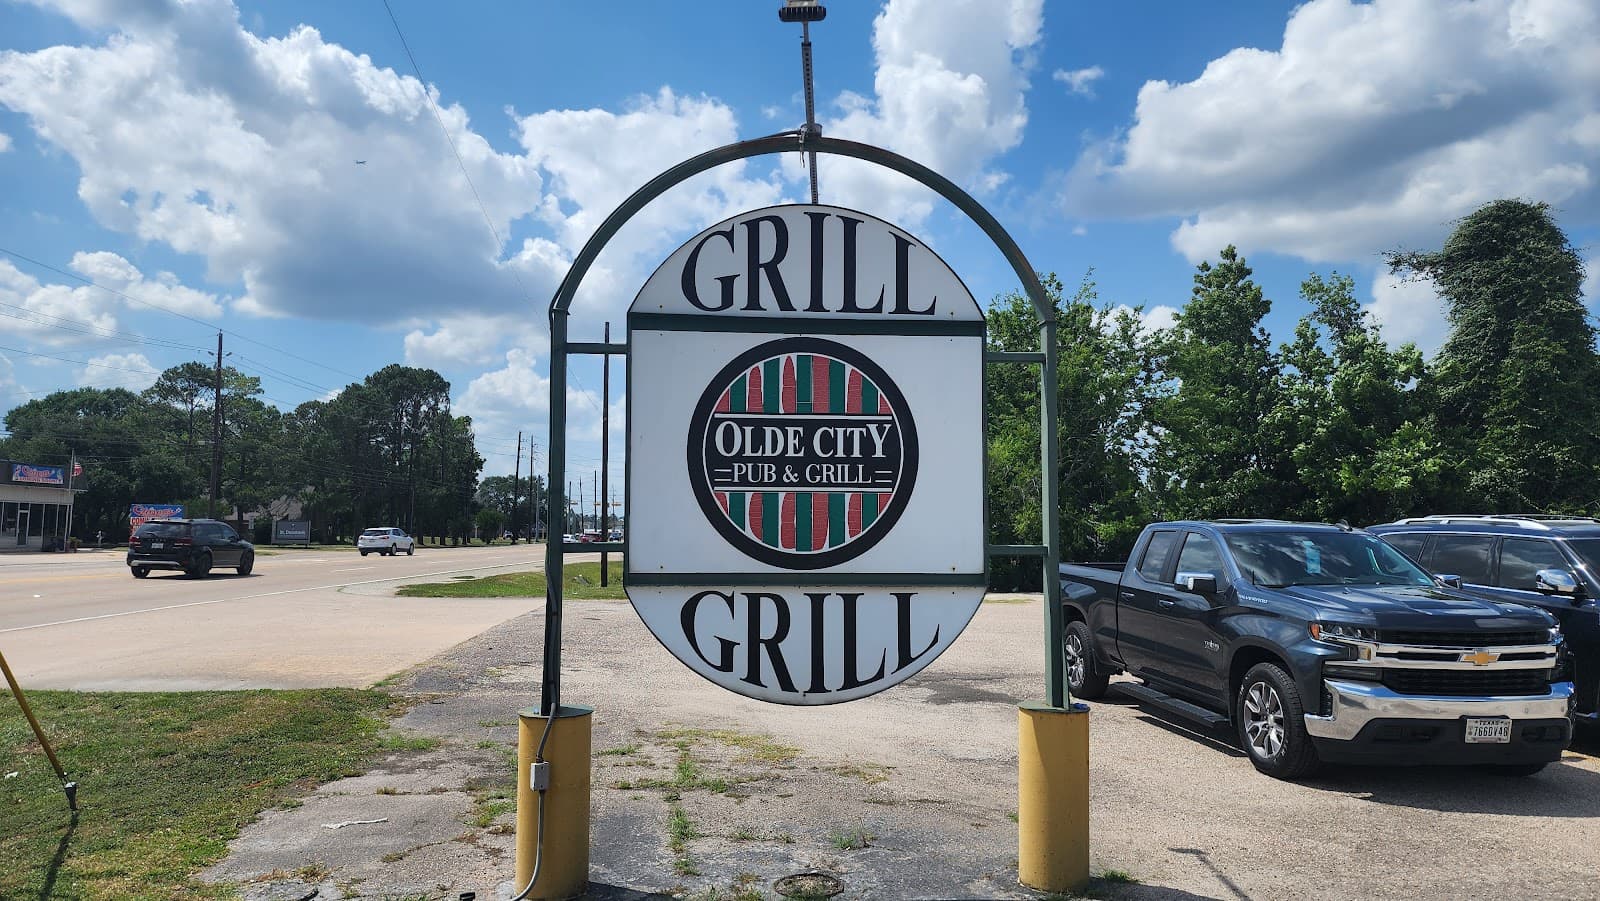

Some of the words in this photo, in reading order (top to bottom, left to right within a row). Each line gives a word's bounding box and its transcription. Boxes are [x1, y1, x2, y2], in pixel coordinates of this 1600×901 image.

[680, 211, 938, 316] GRILL
[714, 420, 805, 457] OLDE
[812, 423, 892, 458] CITY
[732, 462, 777, 483] PUB
[782, 464, 800, 483] &
[805, 463, 872, 484] GRILL
[680, 590, 940, 694] GRILL
